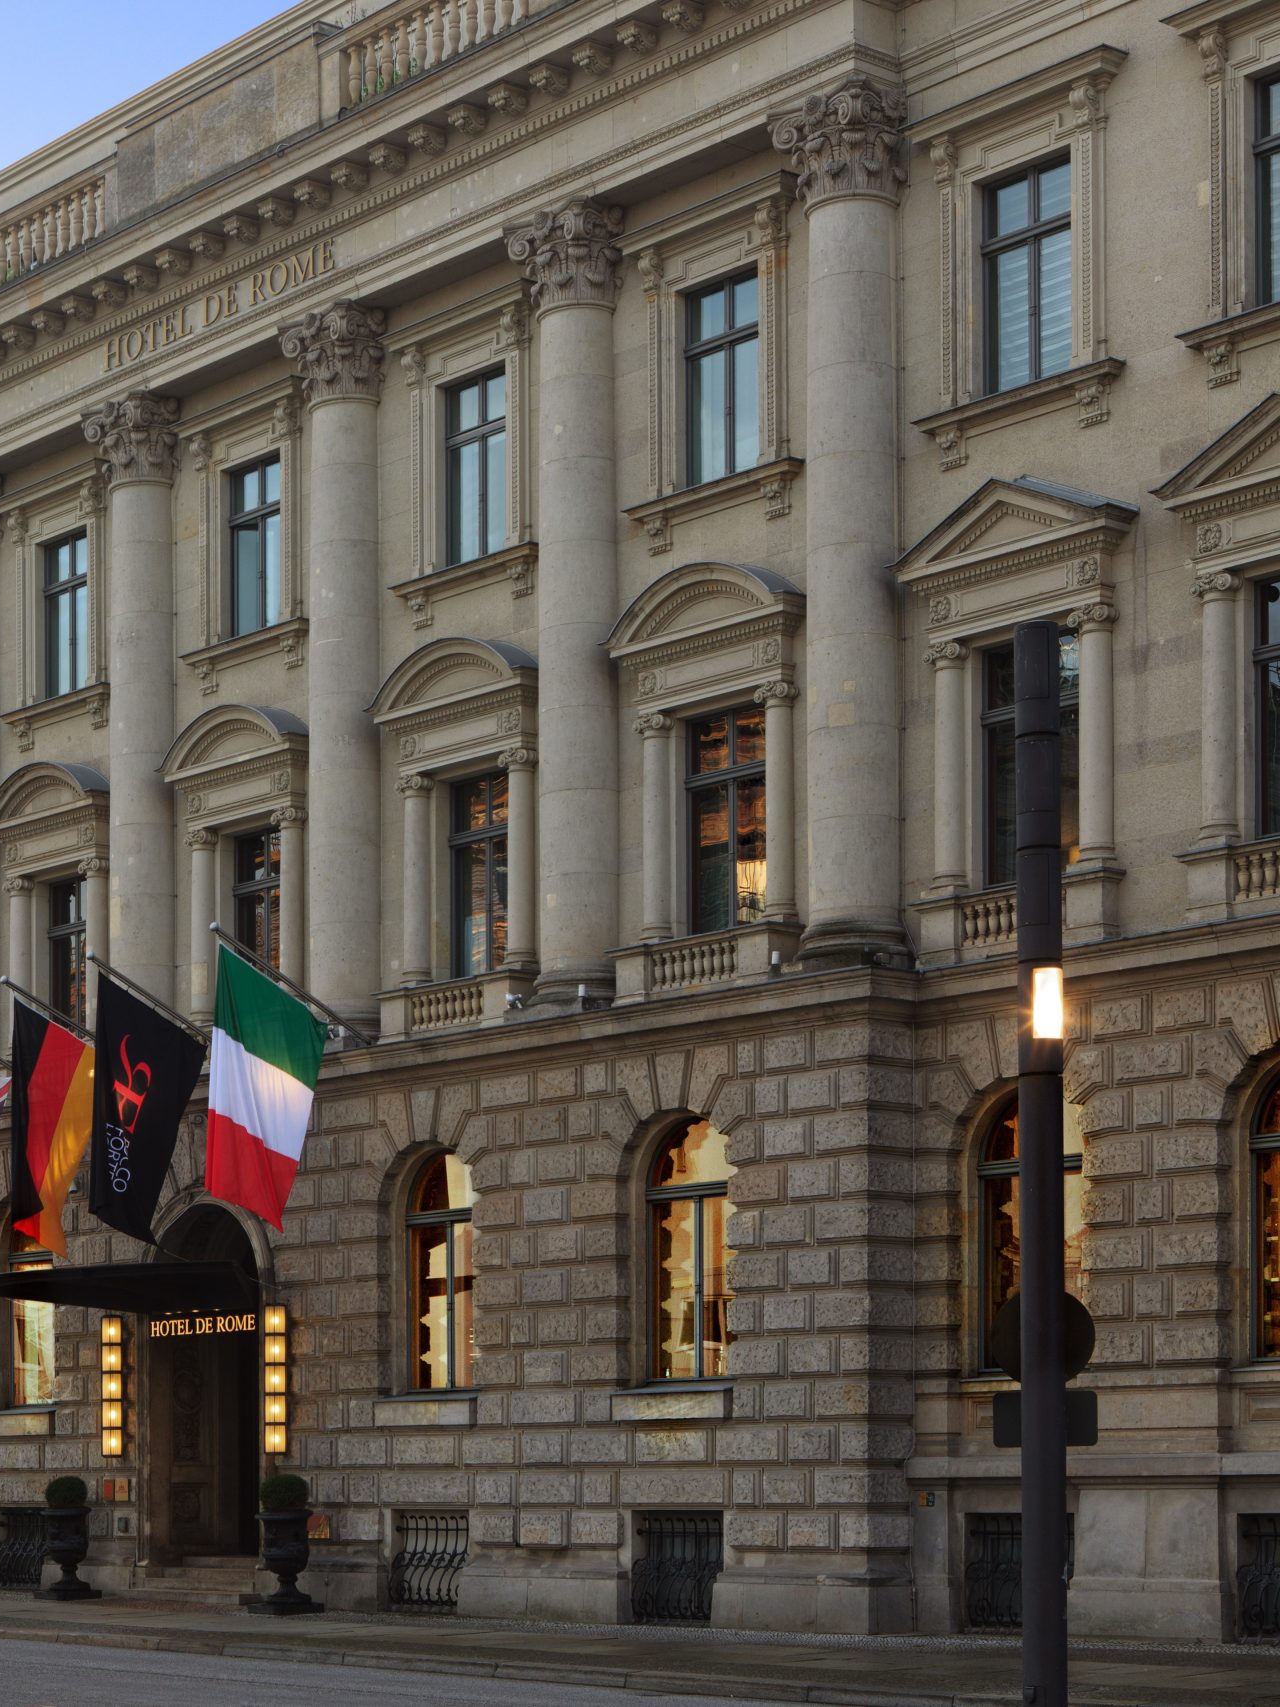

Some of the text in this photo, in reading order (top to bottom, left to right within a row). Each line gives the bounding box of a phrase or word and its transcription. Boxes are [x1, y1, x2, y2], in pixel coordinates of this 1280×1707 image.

[104, 237, 335, 372] HOTEL DE ROME
[150, 1314, 256, 1337] HOTEL DE ROME
